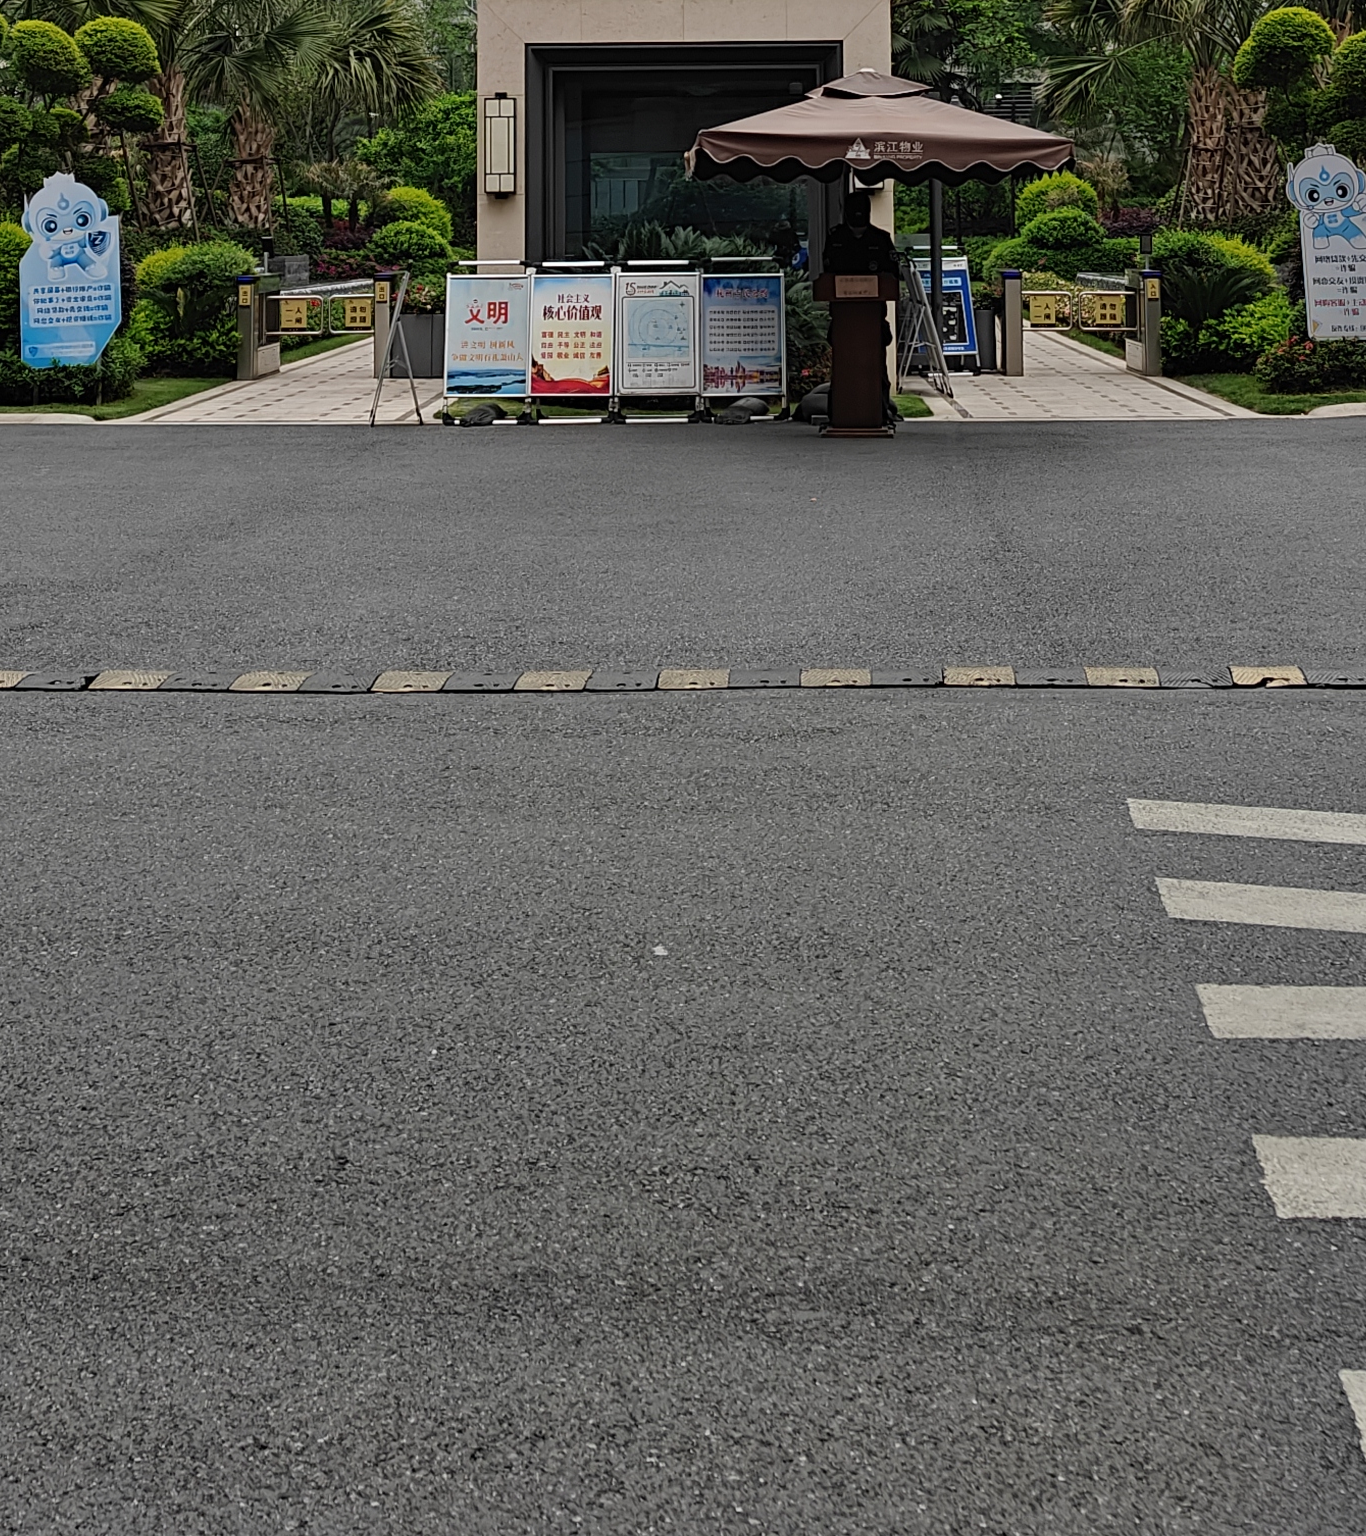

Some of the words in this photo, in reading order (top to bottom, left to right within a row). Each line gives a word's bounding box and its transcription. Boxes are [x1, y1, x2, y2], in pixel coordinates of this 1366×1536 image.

[874, 141, 923, 152] 滨江物业
[558, 294, 590, 303] 社会主义
[464, 299, 509, 325] 文明
[543, 305, 602, 321] 核心价值观
